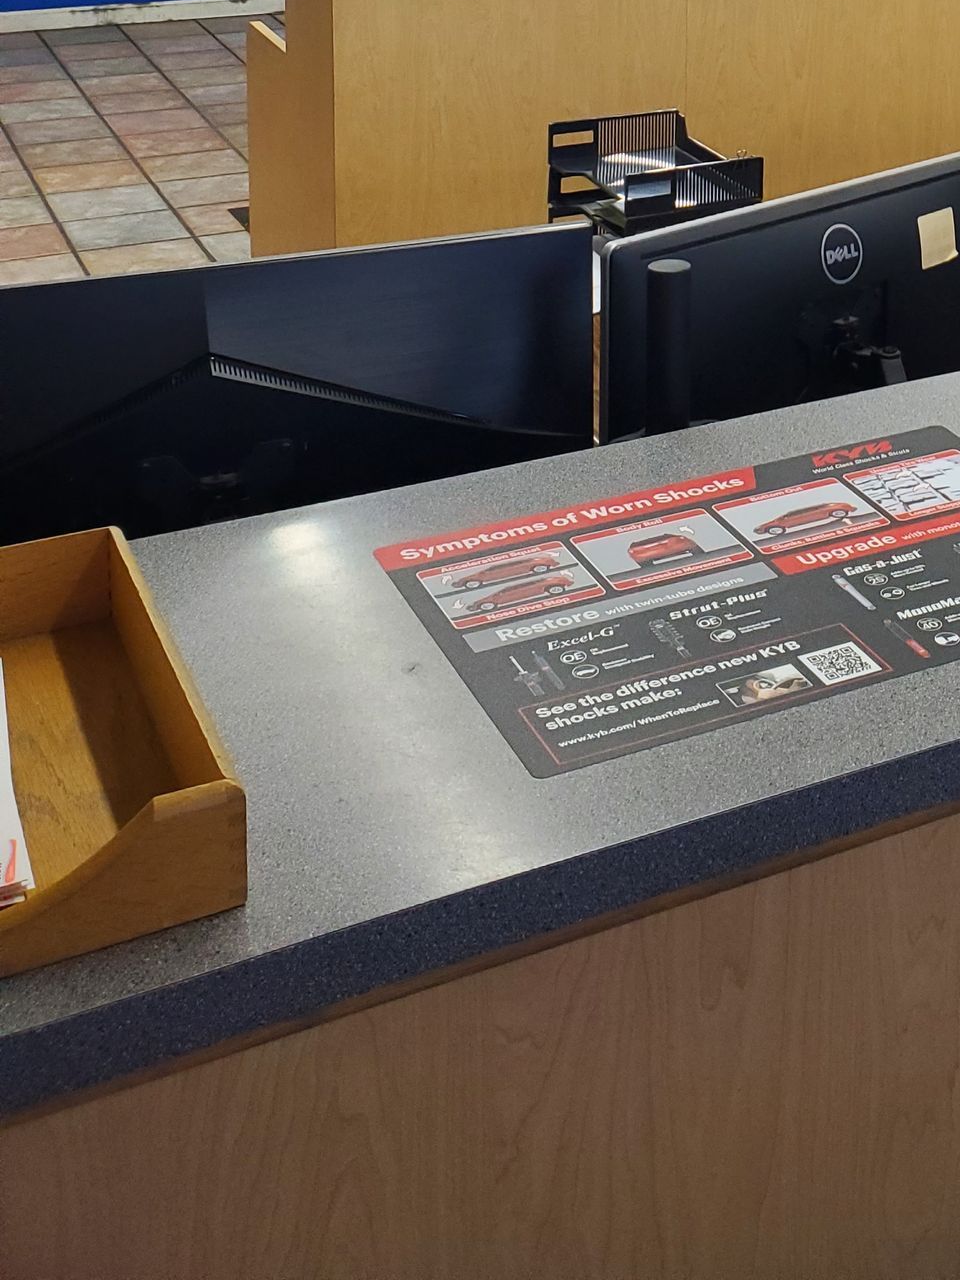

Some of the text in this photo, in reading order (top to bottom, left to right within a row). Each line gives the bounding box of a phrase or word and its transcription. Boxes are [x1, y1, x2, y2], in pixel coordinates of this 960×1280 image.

[826, 243, 859, 265] DELL
[812, 440, 892, 467] KYB
[400, 478, 745, 560] Symptoms of Worn Shocks
[617, 524, 642, 533] Body
[796, 535, 897, 566] Upgrade
[902, 530, 926, 540] with
[487, 596, 570, 621] Nose Dive Stop
[495, 577, 744, 641] Restore with twin-tube designs
[669, 590, 767, 620] Strut-Plus
[535, 640, 801, 720] See the difference new KYB
[545, 687, 683, 731] shocks make:
[637, 699, 720, 727] WhenToReplace
